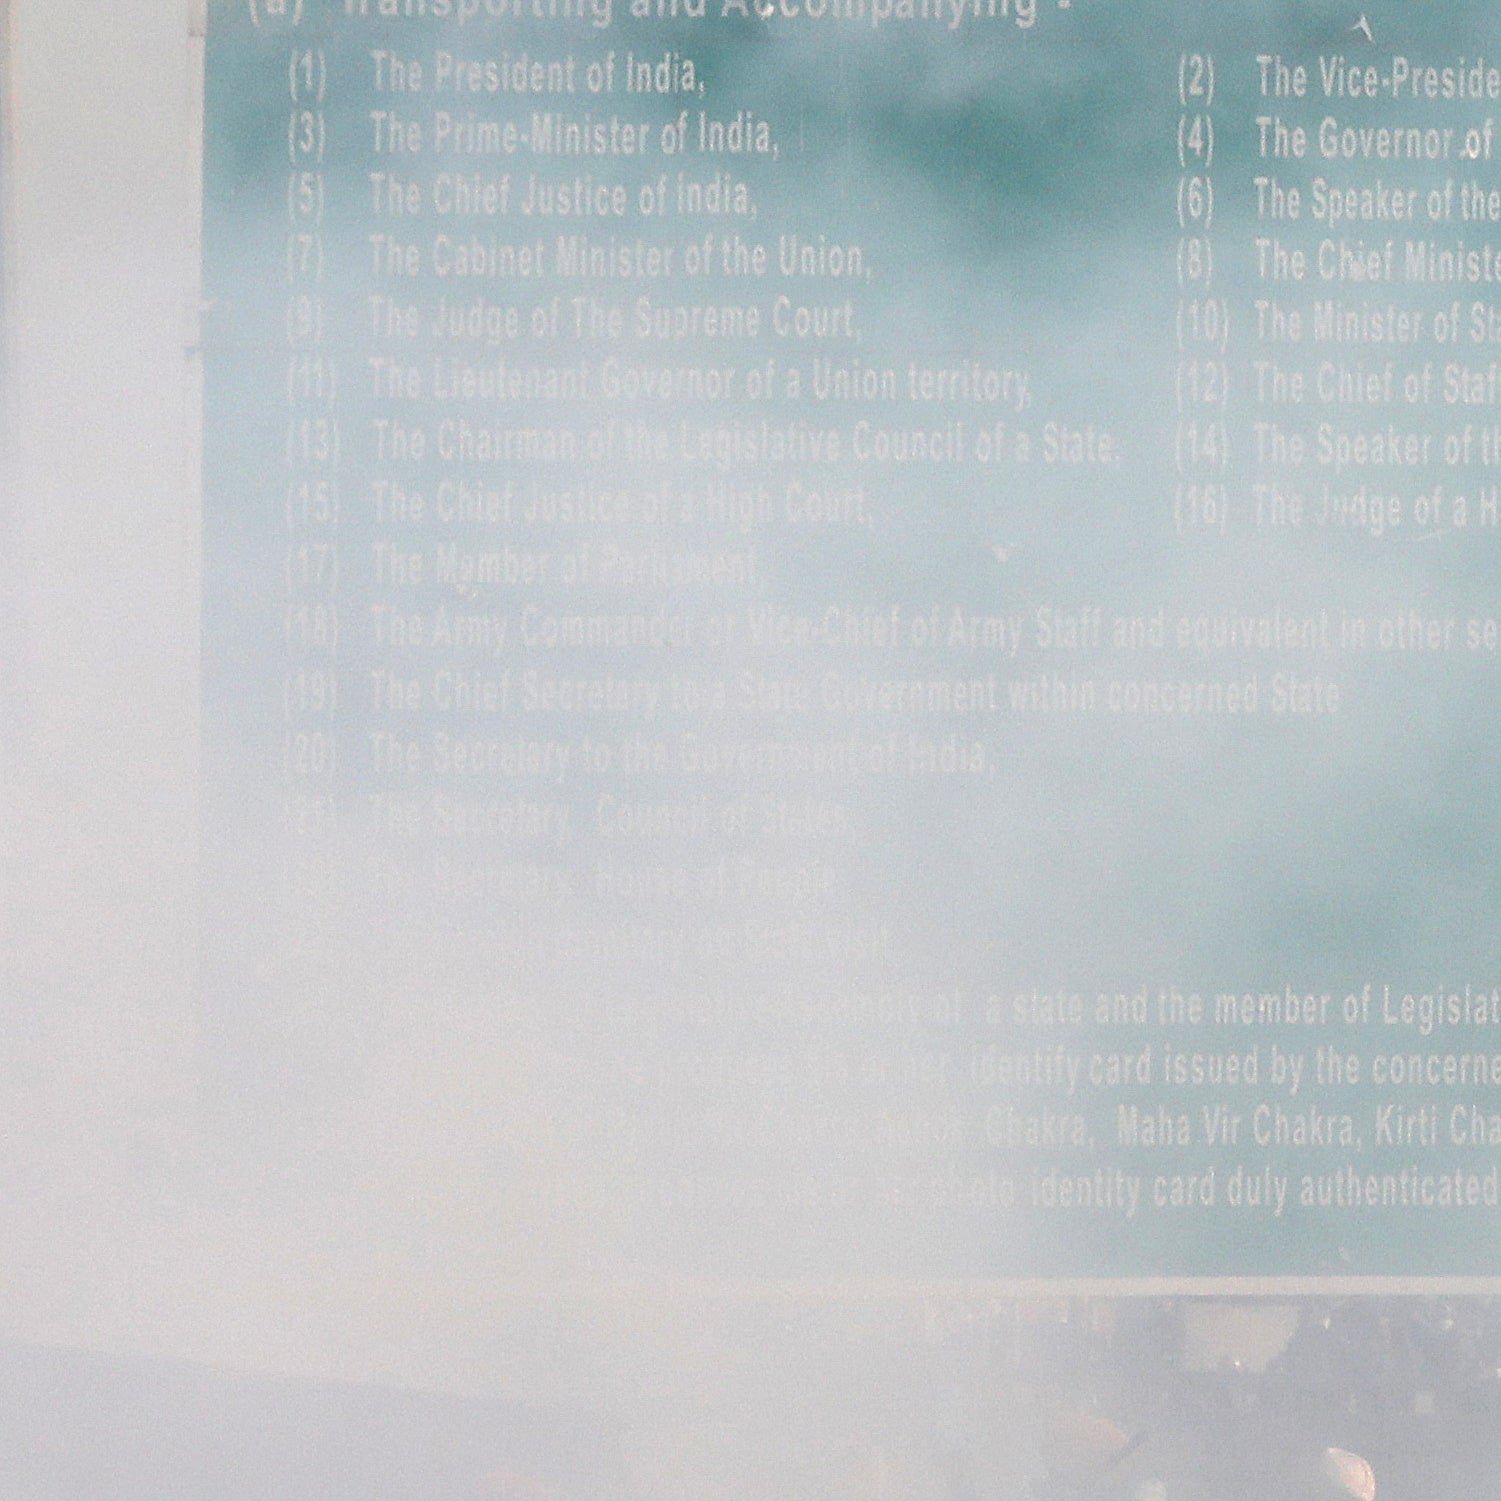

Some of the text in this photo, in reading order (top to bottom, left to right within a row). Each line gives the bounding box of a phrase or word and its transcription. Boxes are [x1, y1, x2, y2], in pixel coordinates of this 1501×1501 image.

[289, 49, 705, 101] (1) The President of India,
[1179, 52, 1214, 106] (2)
[1256, 54, 1306, 97] The
[288, 110, 779, 163] (3) The Prime-Minister of India,
[1178, 114, 1213, 168] (4)
[1256, 116, 1306, 158] The
[1319, 116, 1454, 159] Governor
[1466, 120, 1494, 159] of
[288, 173, 323, 224] (5)
[369, 174, 421, 213] The
[434, 174, 510, 214] Chief
[521, 174, 627, 215] Justice
[639, 175, 668, 215] of
[1178, 176, 1213, 228] (6)
[1254, 177, 1301, 219] The
[1312, 178, 1417, 228] Speaker
[1427, 179, 1454, 221] of
[1461, 181, 1499, 221] the
[1177, 239, 1212, 289] (8)
[1255, 239, 1304, 282] The
[1318, 240, 1393, 282] Chief
[1176, 300, 1228, 353] (10)
[1254, 300, 1301, 341] The
[1315, 303, 1423, 342] Minister
[1434, 303, 1461, 342] of
[1253, 423, 1301, 463] The
[1318, 423, 1431, 474] Speaker
[1444, 426, 1471, 465] of
[1013, 985, 1083, 1024] state
[1096, 984, 1147, 1023] and
[1159, 983, 1202, 1023] the
[1215, 982, 1330, 1023] member
[1343, 982, 1371, 1024] of
[1089, 1043, 1149, 1085] card
[1165, 1043, 1257, 1084] issued
[1272, 1043, 1303, 1096] by
[1316, 1043, 1359, 1084] the
[1118, 1103, 1190, 1146] Maha
[1204, 1104, 1241, 1146] Vir
[1253, 1102, 1362, 1151] Chakra,
[1375, 1103, 1437, 1144] Kirti
[1153, 1165, 1215, 1207] card
[1227, 1164, 1287, 1217] duly
[1300, 1164, 1497, 1207] authenticated
